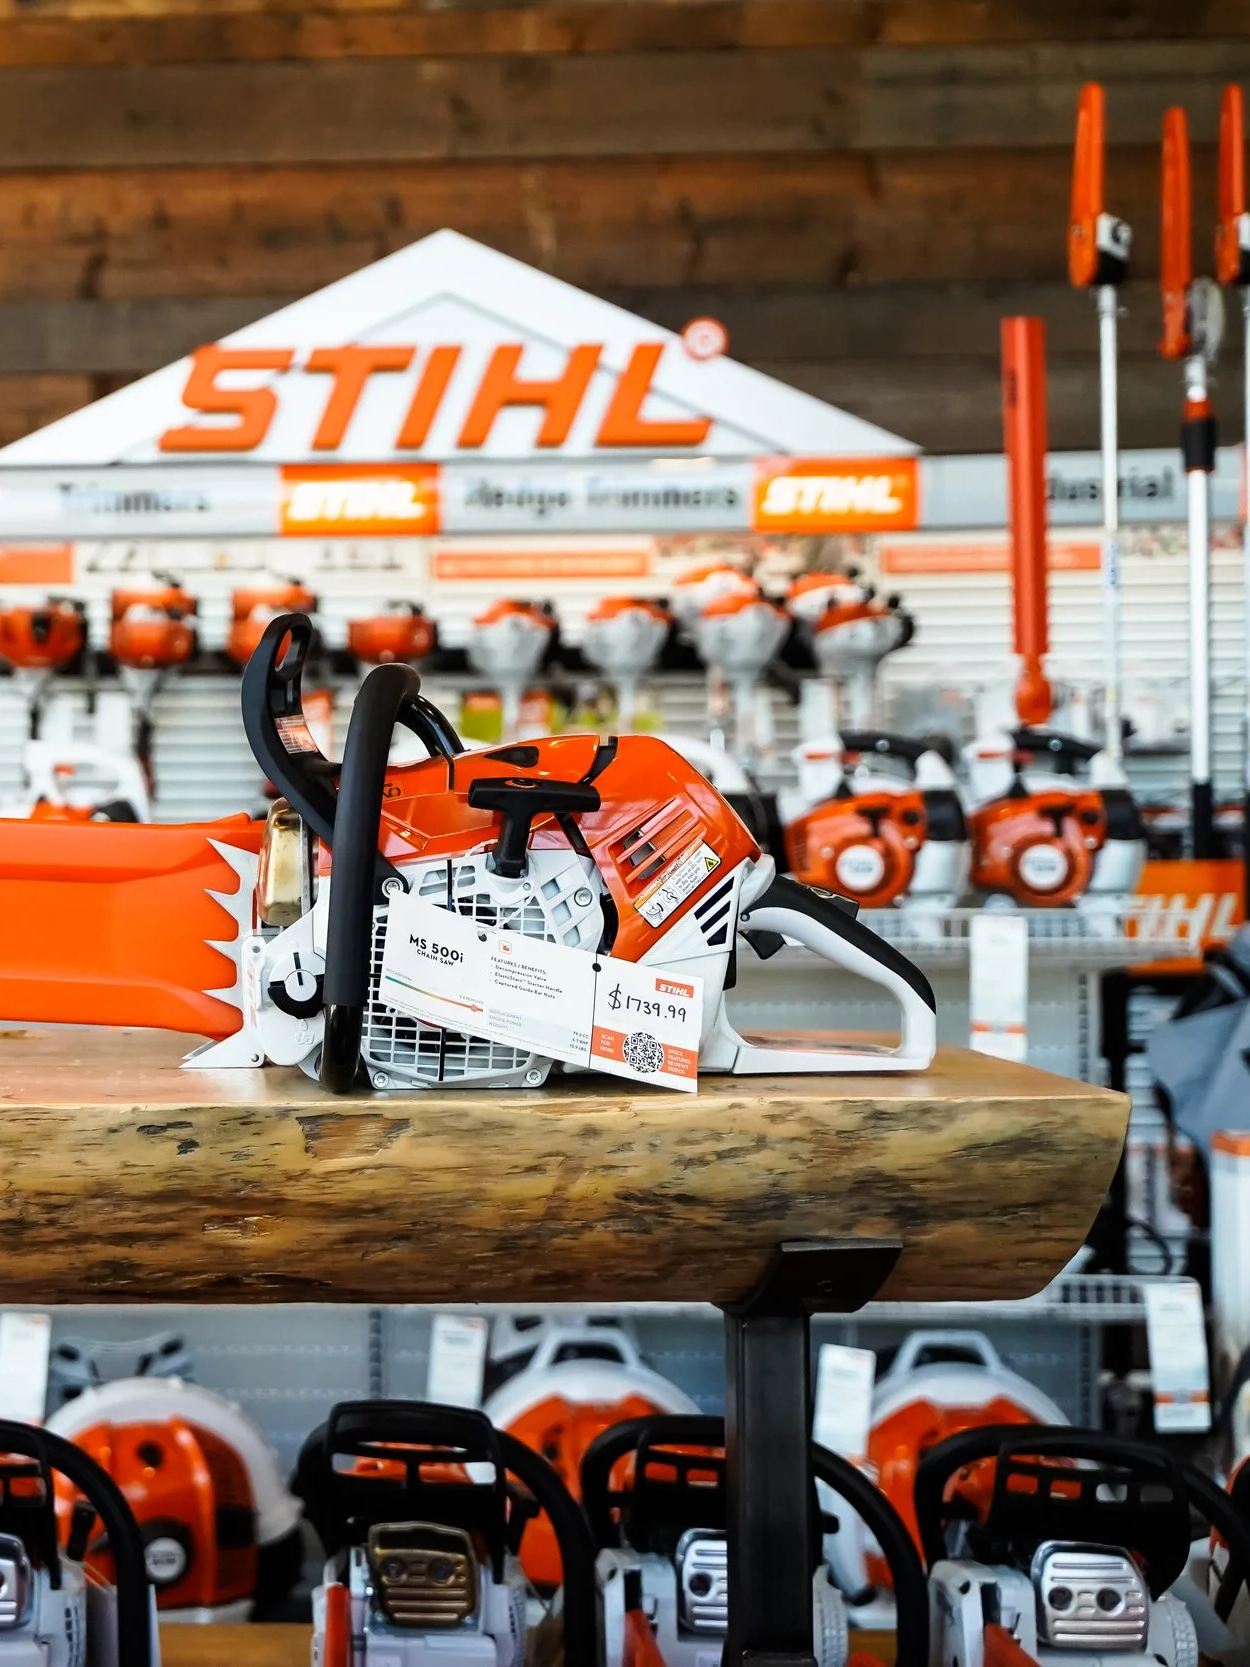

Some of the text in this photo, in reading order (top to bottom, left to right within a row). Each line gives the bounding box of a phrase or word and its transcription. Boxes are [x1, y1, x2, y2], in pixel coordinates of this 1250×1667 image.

[158, 342, 713, 452] STIHL
[286, 480, 426, 520] STIHL
[761, 476, 903, 515] STIHL
[409, 933, 464, 963] MS 500i
[416, 948, 455, 966] CHAIN SAW
[491, 956, 517, 968] FEATURES
[495, 964, 547, 982] Decompression Valve
[494, 979, 518, 989] Captured
[518, 985, 534, 994] Guide
[543, 991, 556, 999] Nuts
[527, 979, 545, 989] Starter
[545, 985, 563, 994] Handle
[658, 983, 690, 997] STIHL
[600, 1033, 615, 1041] SCAN
[599, 1046, 615, 1054] MORE
[667, 1048, 684, 1057] SPECS
[667, 1054, 692, 1065] FEATURES
[667, 1060, 690, 1070] REVIEWS
[667, 1066, 686, 1075] VIDEOS
